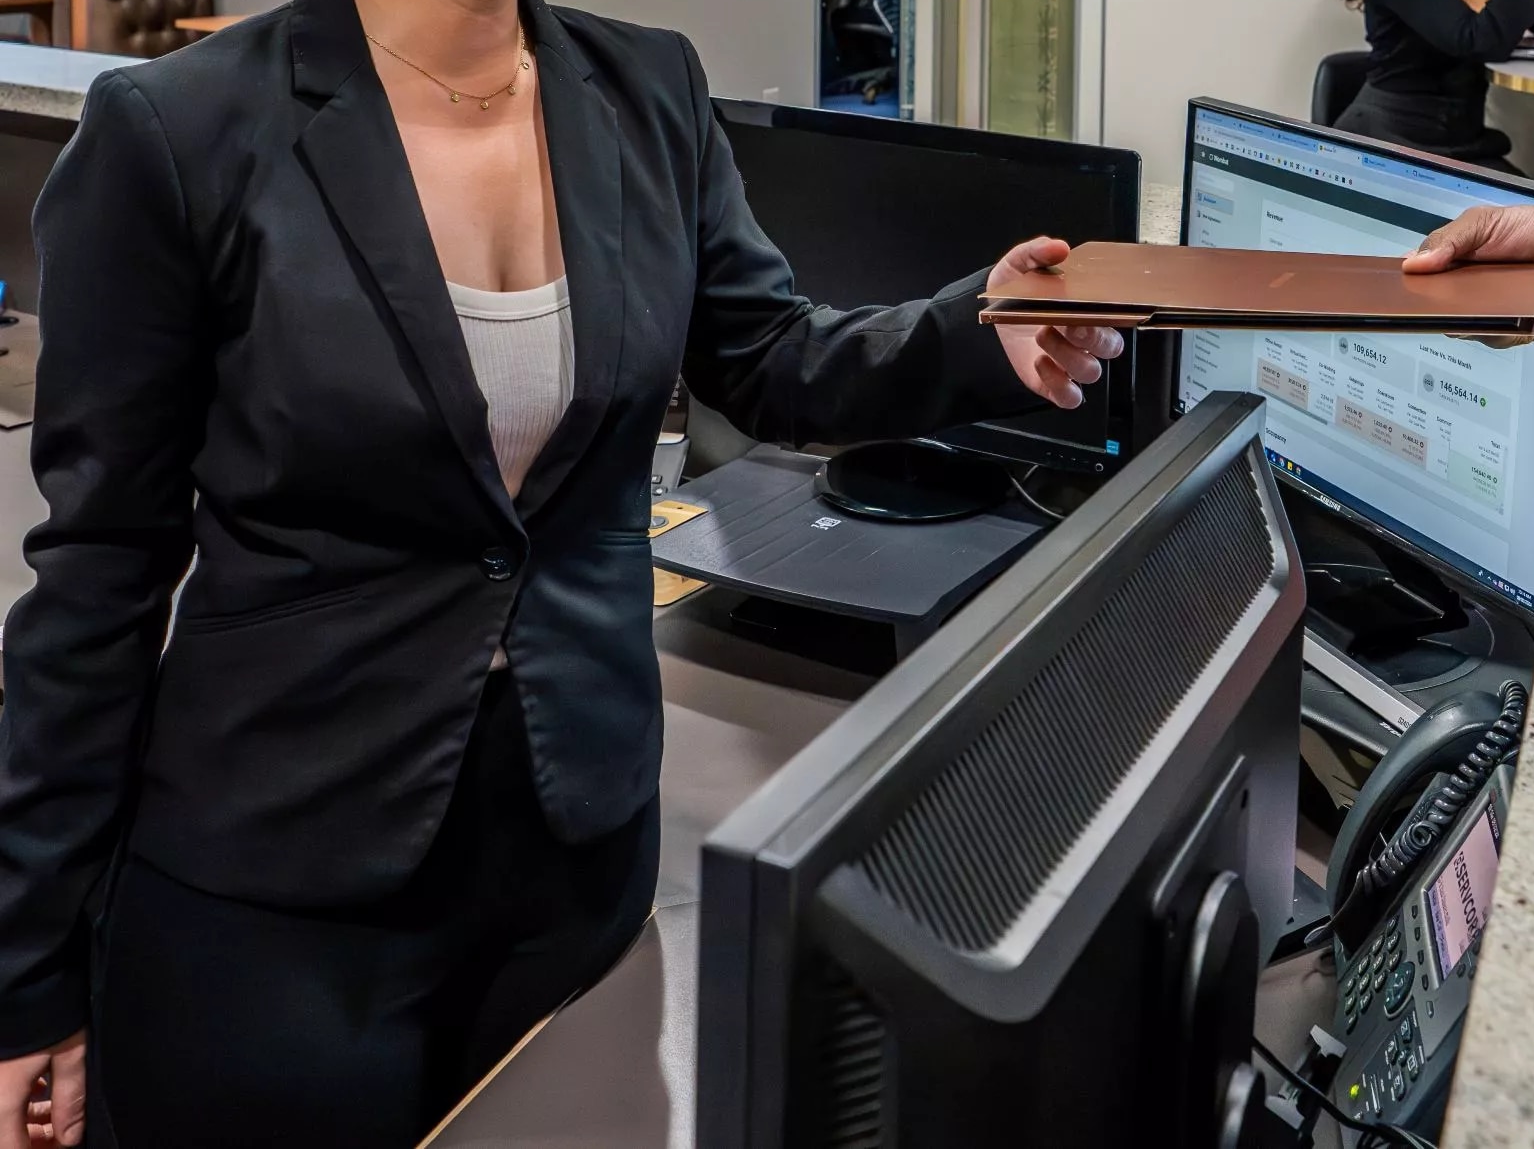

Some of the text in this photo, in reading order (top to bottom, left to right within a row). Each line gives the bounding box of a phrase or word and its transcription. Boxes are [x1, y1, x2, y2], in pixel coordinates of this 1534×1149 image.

[1353, 343, 1387, 364] 109,654.12
[1457, 358, 1472, 370] Month
[1440, 380, 1478, 404] 146,564.14
